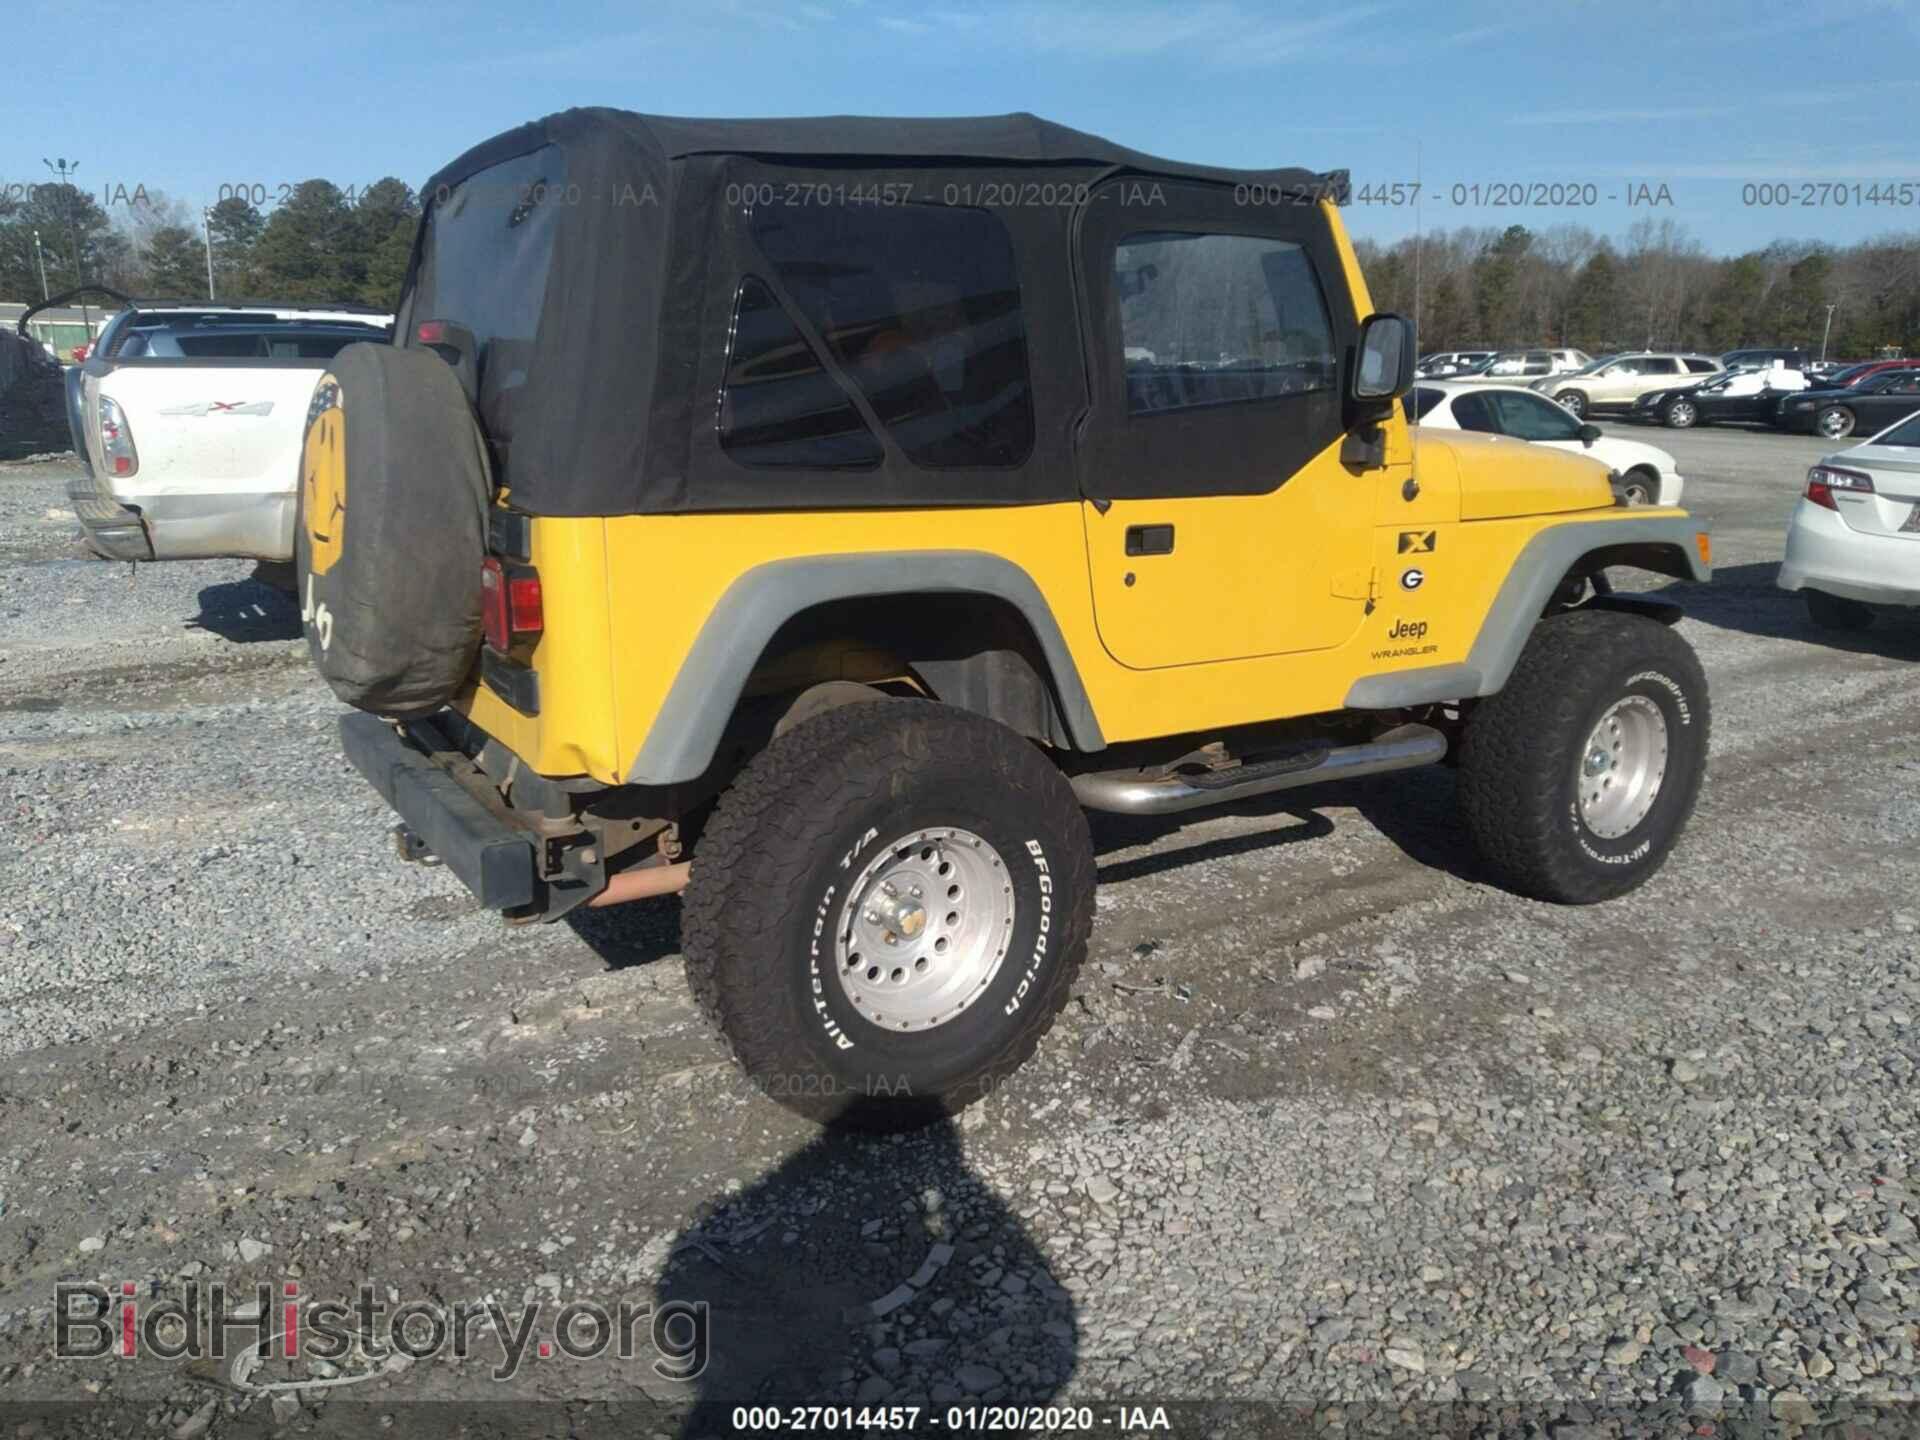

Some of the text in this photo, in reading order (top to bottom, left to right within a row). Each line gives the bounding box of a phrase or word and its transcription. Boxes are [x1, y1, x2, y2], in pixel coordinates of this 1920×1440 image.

[1401, 568, 1424, 590] G
[1388, 619, 1428, 639] Jeep
[1371, 645, 1438, 660] WRANGLER
[840, 827, 879, 870] T/A
[1004, 839, 1053, 1016] BFGoodrich
